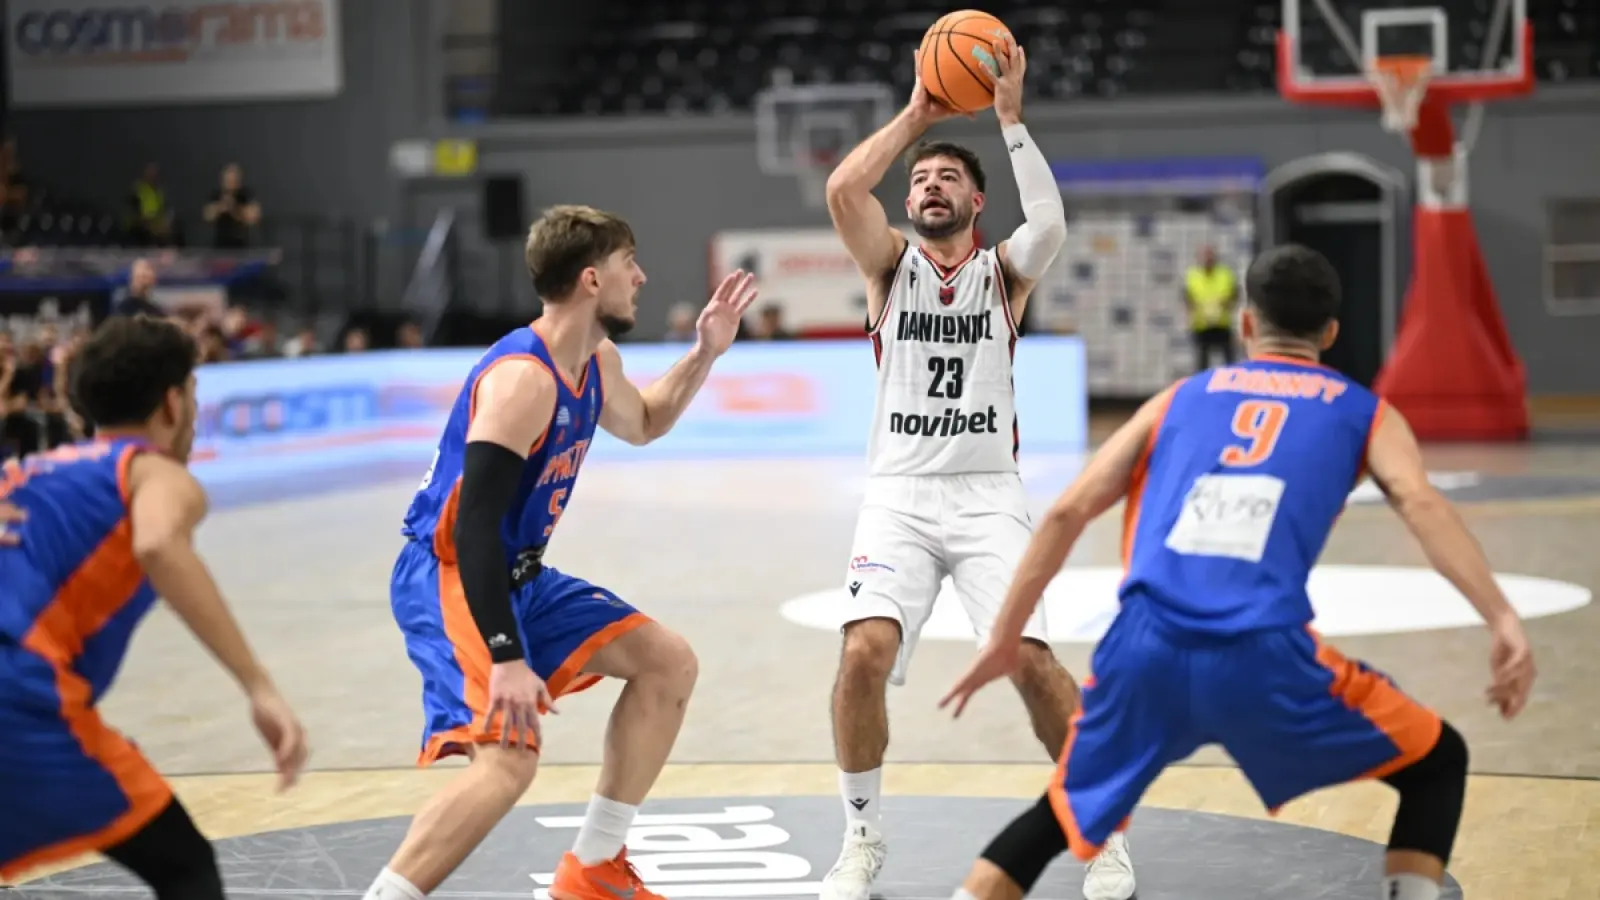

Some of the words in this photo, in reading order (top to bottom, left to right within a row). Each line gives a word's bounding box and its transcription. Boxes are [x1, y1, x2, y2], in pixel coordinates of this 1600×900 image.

[927, 356, 964, 400] 23
[890, 405, 997, 437] novibet
[1219, 400, 1289, 467] 9
